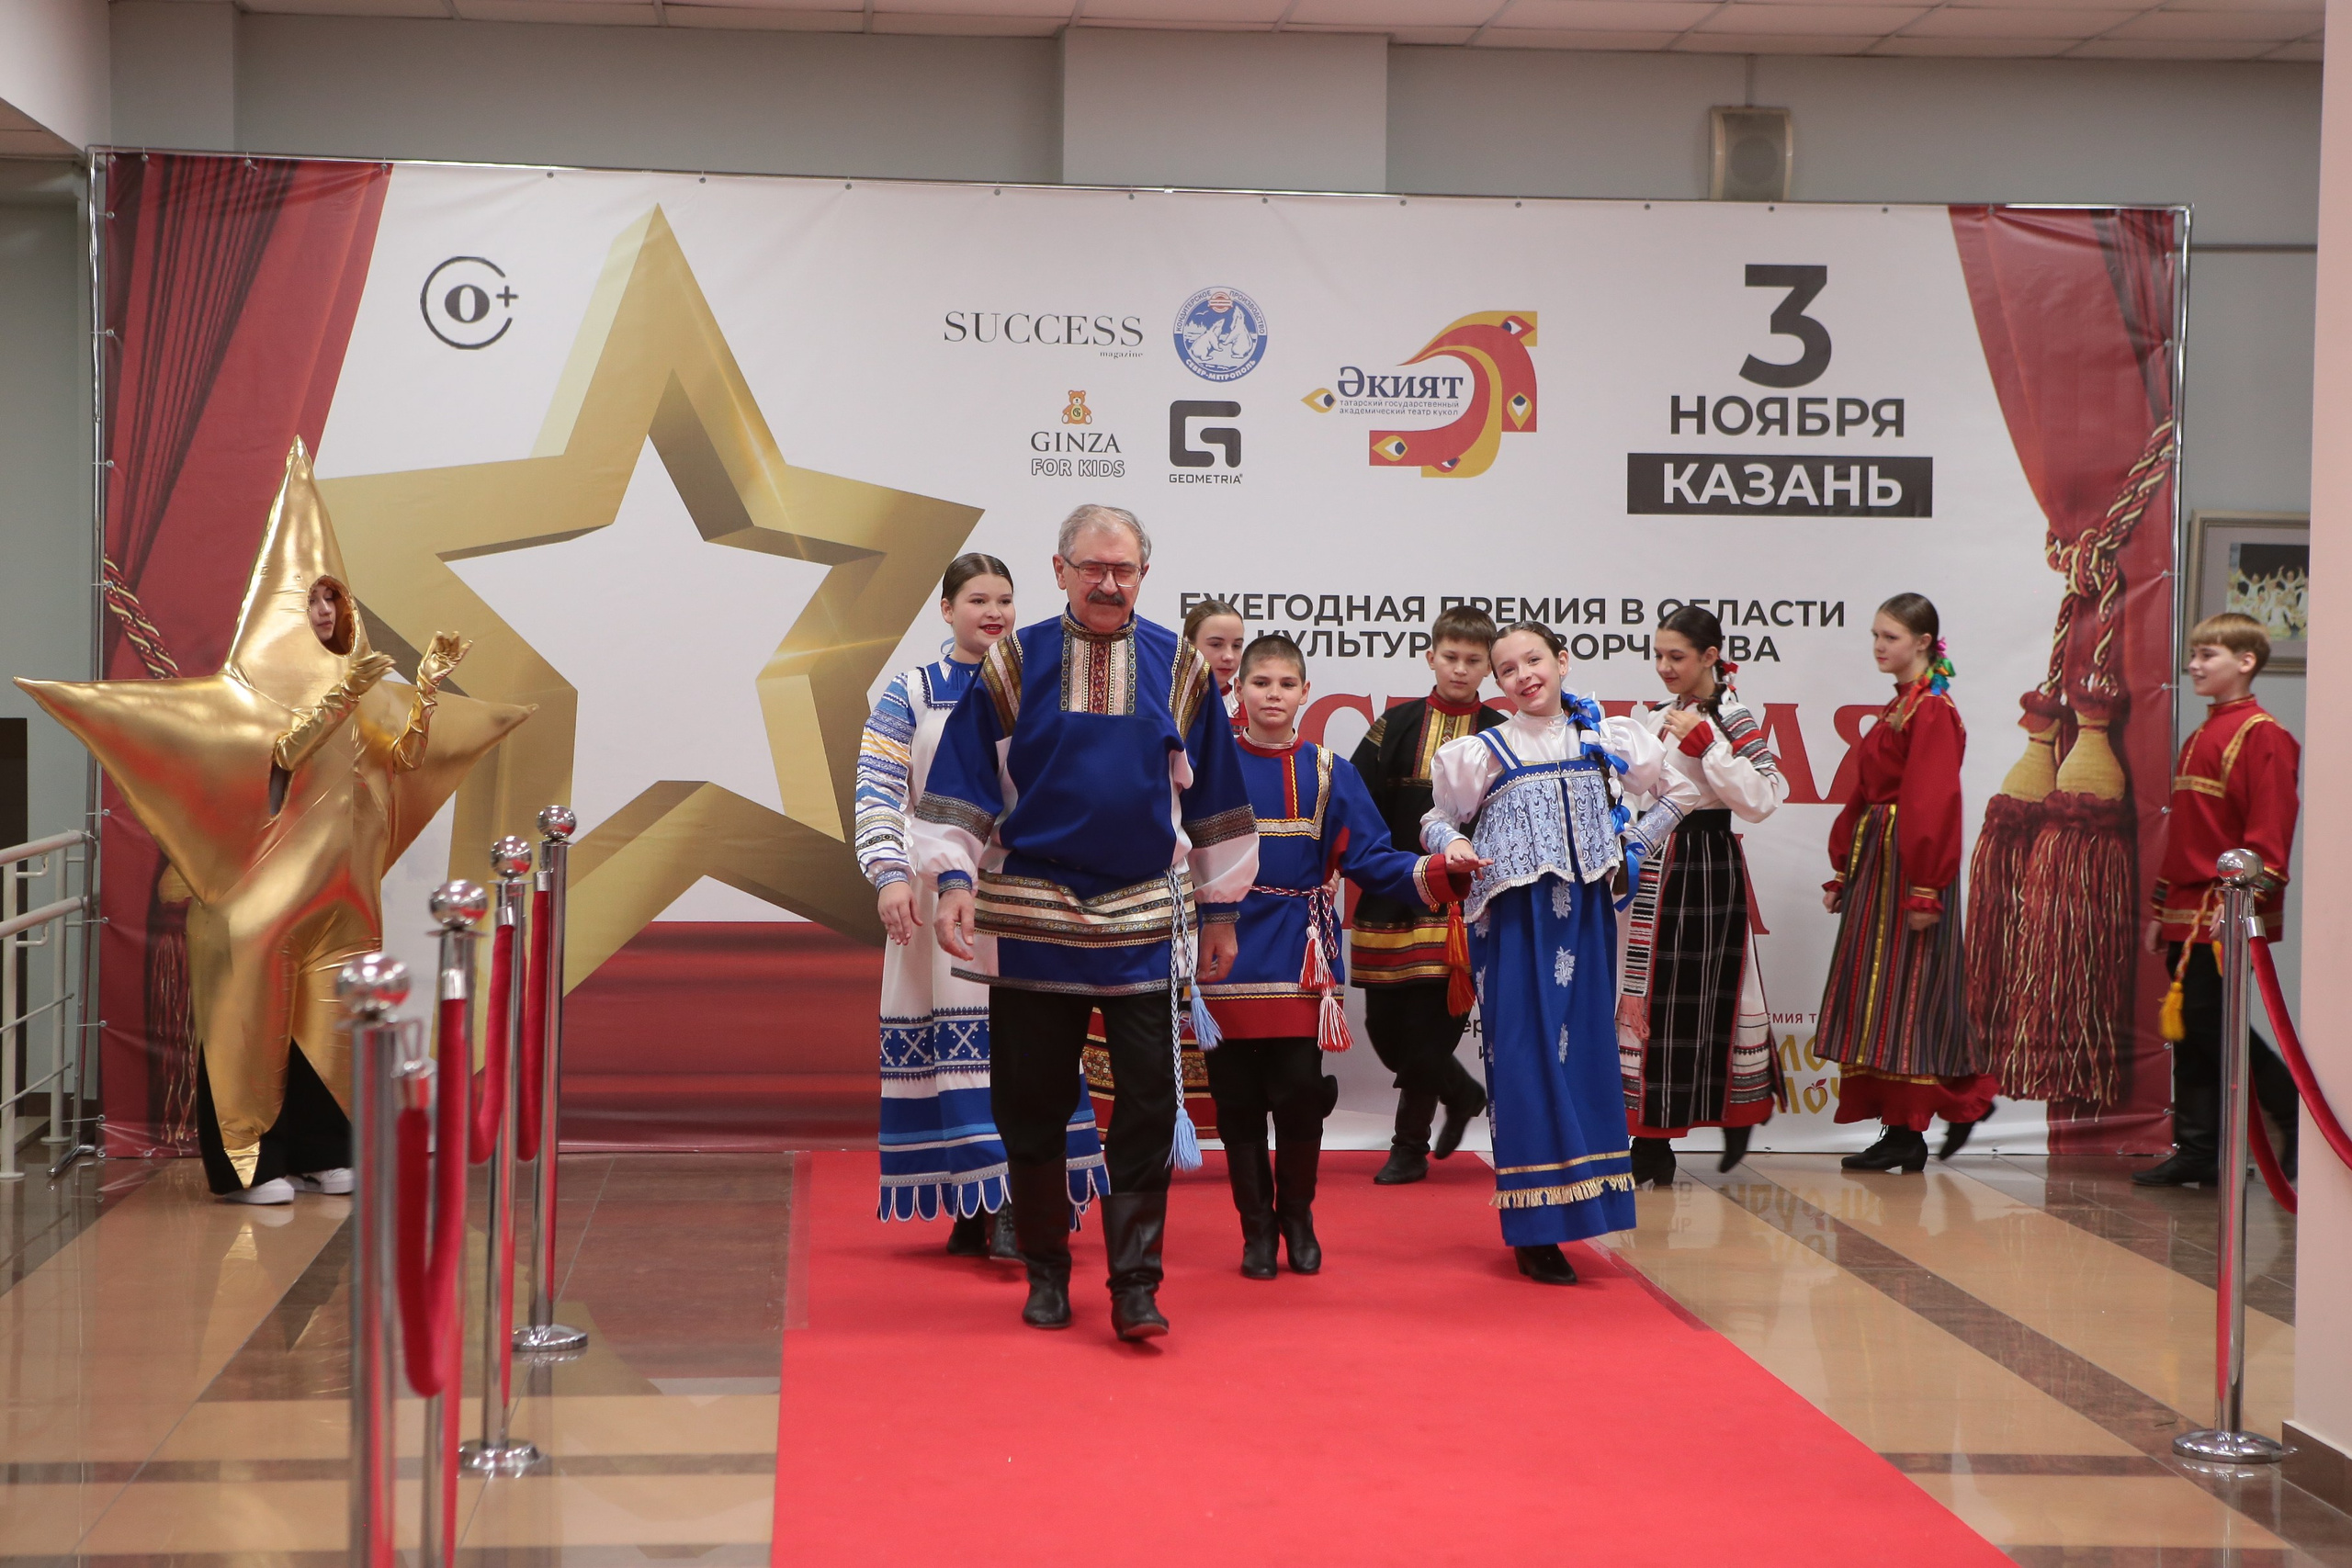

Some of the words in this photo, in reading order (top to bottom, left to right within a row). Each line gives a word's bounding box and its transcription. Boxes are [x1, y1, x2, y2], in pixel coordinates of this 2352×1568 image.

[1175, 289, 1212, 333] КОНДИТЕРСКОЕ
[1229, 290, 1265, 333] ПРОИЗВОДСТВО
[944, 310, 1144, 347] SUCCESS
[1738, 264, 1832, 389] 3
[1100, 350, 1144, 360] magazine
[1185, 358, 1257, 381] СЕВЕР-МЕТРОПОЛЬ
[1339, 408, 1406, 416] академический
[1340, 399, 1383, 408] татарский
[1385, 400, 1459, 410] государственный
[1670, 395, 1905, 437] НОЯБРЯ
[1030, 431, 1122, 454] GINZA
[1031, 457, 1072, 477] FOR
[1078, 458, 1125, 478] KIDS
[1664, 462, 1903, 507] КАЗАНЬ
[1621, 598, 1645, 625] В
[1657, 598, 1845, 627] ОЛАСТИ
